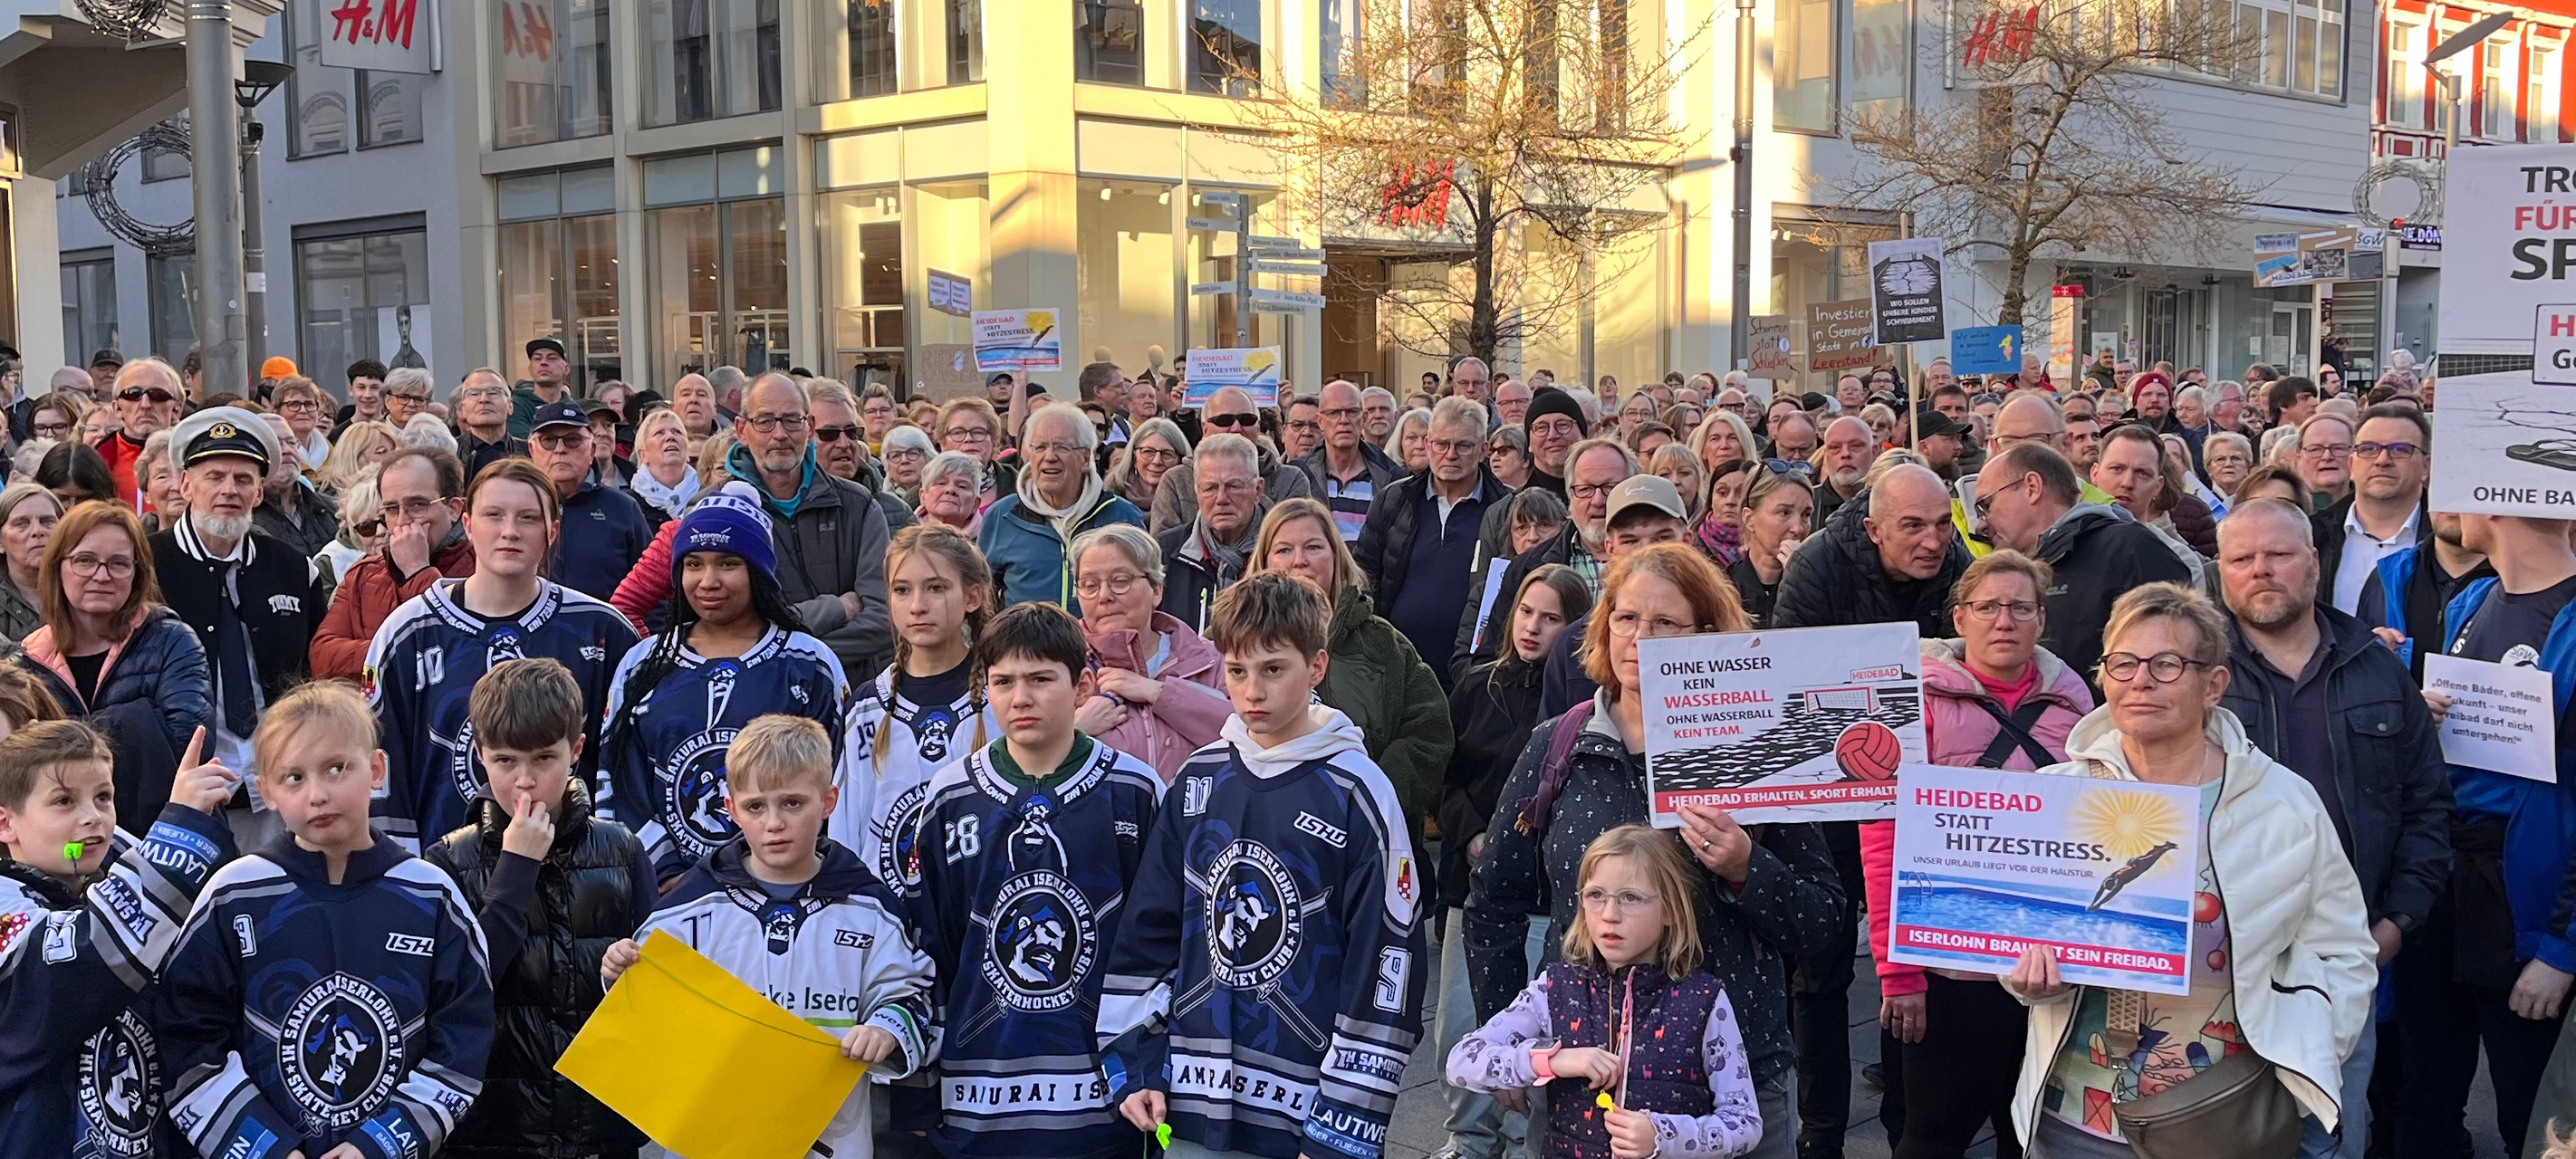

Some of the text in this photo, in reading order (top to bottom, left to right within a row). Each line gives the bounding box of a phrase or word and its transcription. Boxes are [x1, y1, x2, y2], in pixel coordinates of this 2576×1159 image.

[332, 0, 418, 49] H&M
[1812, 330, 1823, 340] in
[1812, 349, 1878, 369] Leerstand!
[2473, 486, 2537, 503] OHNE
[1660, 656, 1772, 675] OHNE WASSER
[1852, 667, 1898, 680] HEIDEBAD
[1683, 678, 1715, 690] KEIN
[1664, 689, 1774, 709] WASSERBALL.
[2511, 691, 2542, 703] offene
[1667, 709, 1774, 725] OHNE WASSERBALL
[2498, 704, 2527, 715] unser
[1674, 725, 1744, 739] KEIN TEAM.
[2446, 713, 2533, 733] reibad darf nicht
[1063, 770, 1105, 805] EIN TEAM
[1668, 793, 1741, 808] HEIDEBAD
[1745, 790, 1807, 803] ERHALTEN.
[1810, 788, 1846, 800] SPORT
[1915, 787, 2043, 812] HEIDEBAD
[1935, 813, 1994, 830] STATT
[1946, 833, 2112, 862] HITZESTRESS.
[1913, 856, 2095, 878] UNSER URLAUB LIEGT VOR DER HAUSTÜR.
[1246, 844, 1297, 905] ISERLOHN
[1287, 908, 1301, 934] e.V.
[806, 900, 822, 915] EIN
[1033, 874, 1090, 918] ISERLOHN
[1081, 920, 1095, 944] e.V.
[1908, 929, 1985, 950] ISERLOHN
[2066, 946, 2100, 962] SEIN
[2103, 950, 2174, 972] FREIBAD.
[1260, 945, 1293, 980] CLUB
[983, 960, 1075, 1011] SKATERHOCKEY
[282, 1044, 296, 1063] IH
[1337, 1049, 1357, 1068] IH
[362, 1074, 395, 1112] CLUB
